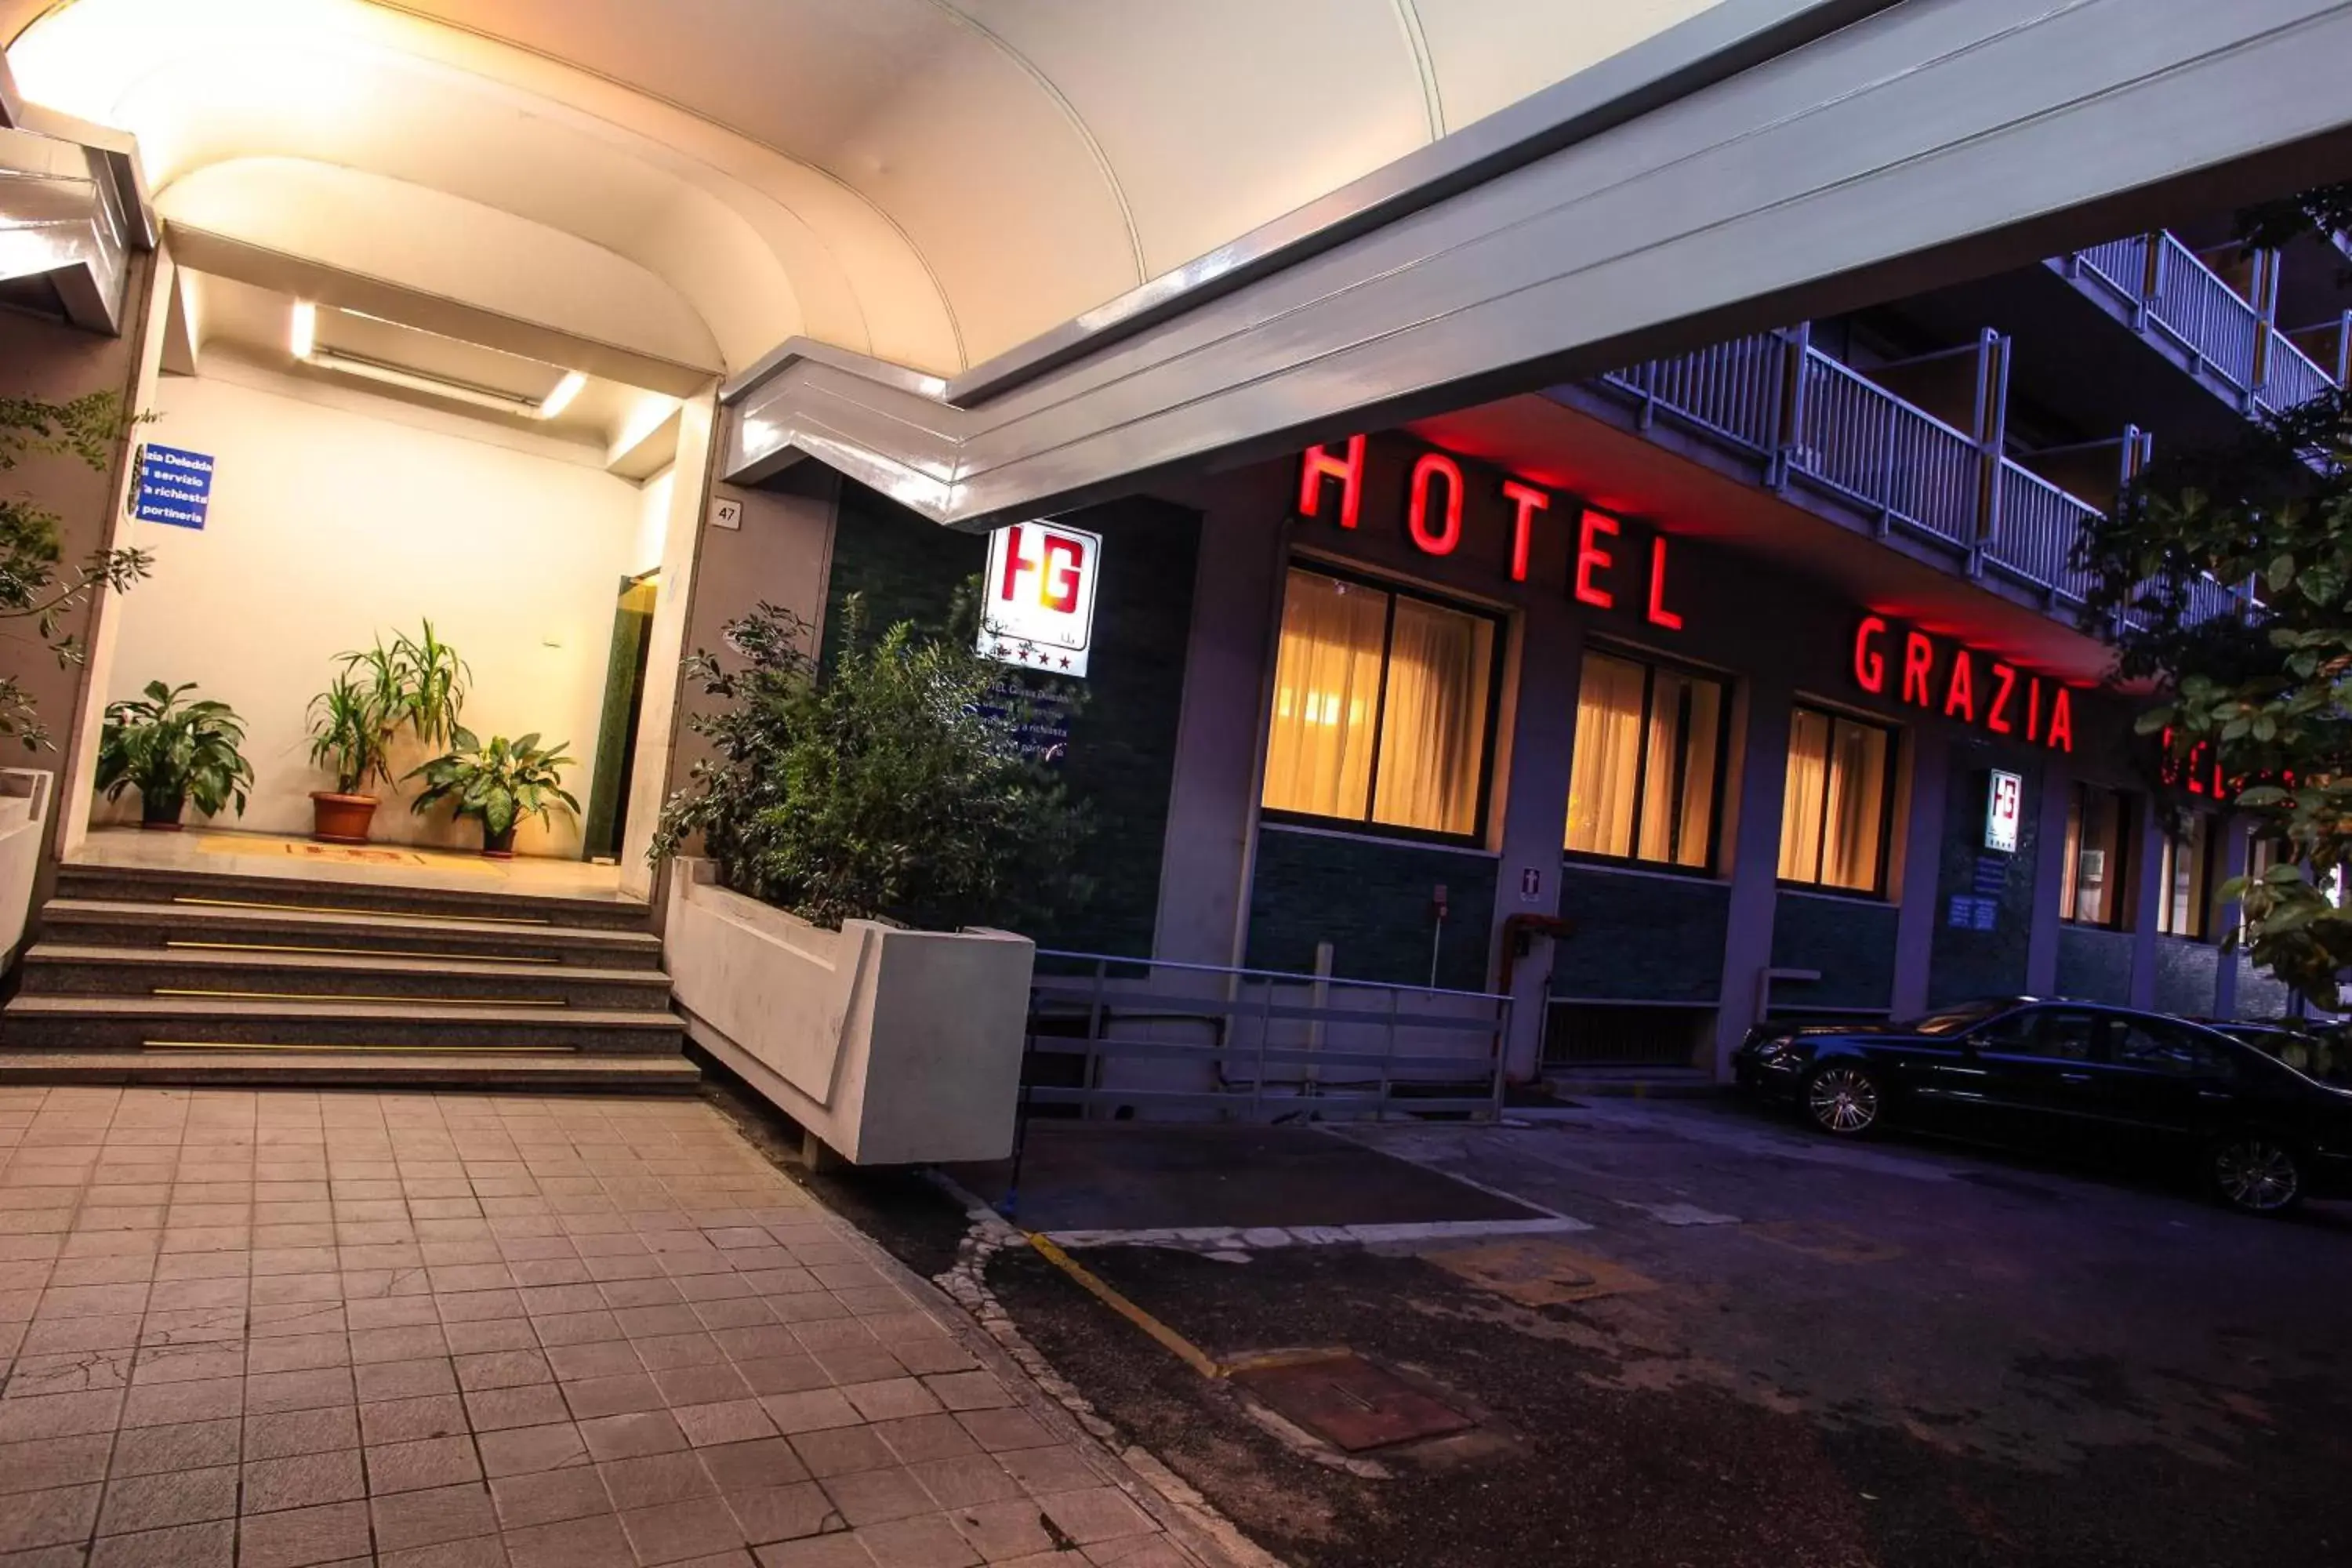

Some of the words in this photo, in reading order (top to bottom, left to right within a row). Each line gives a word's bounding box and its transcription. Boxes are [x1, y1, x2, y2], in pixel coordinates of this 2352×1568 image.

[147, 452, 163, 463] zia
[165, 453, 212, 471] Deledda
[154, 470, 204, 488] servizio
[142, 505, 202, 523] portineria
[718, 506, 735, 521] 47
[1298, 433, 1683, 631] HOTEL
[1854, 616, 2074, 754] GRAZIA
